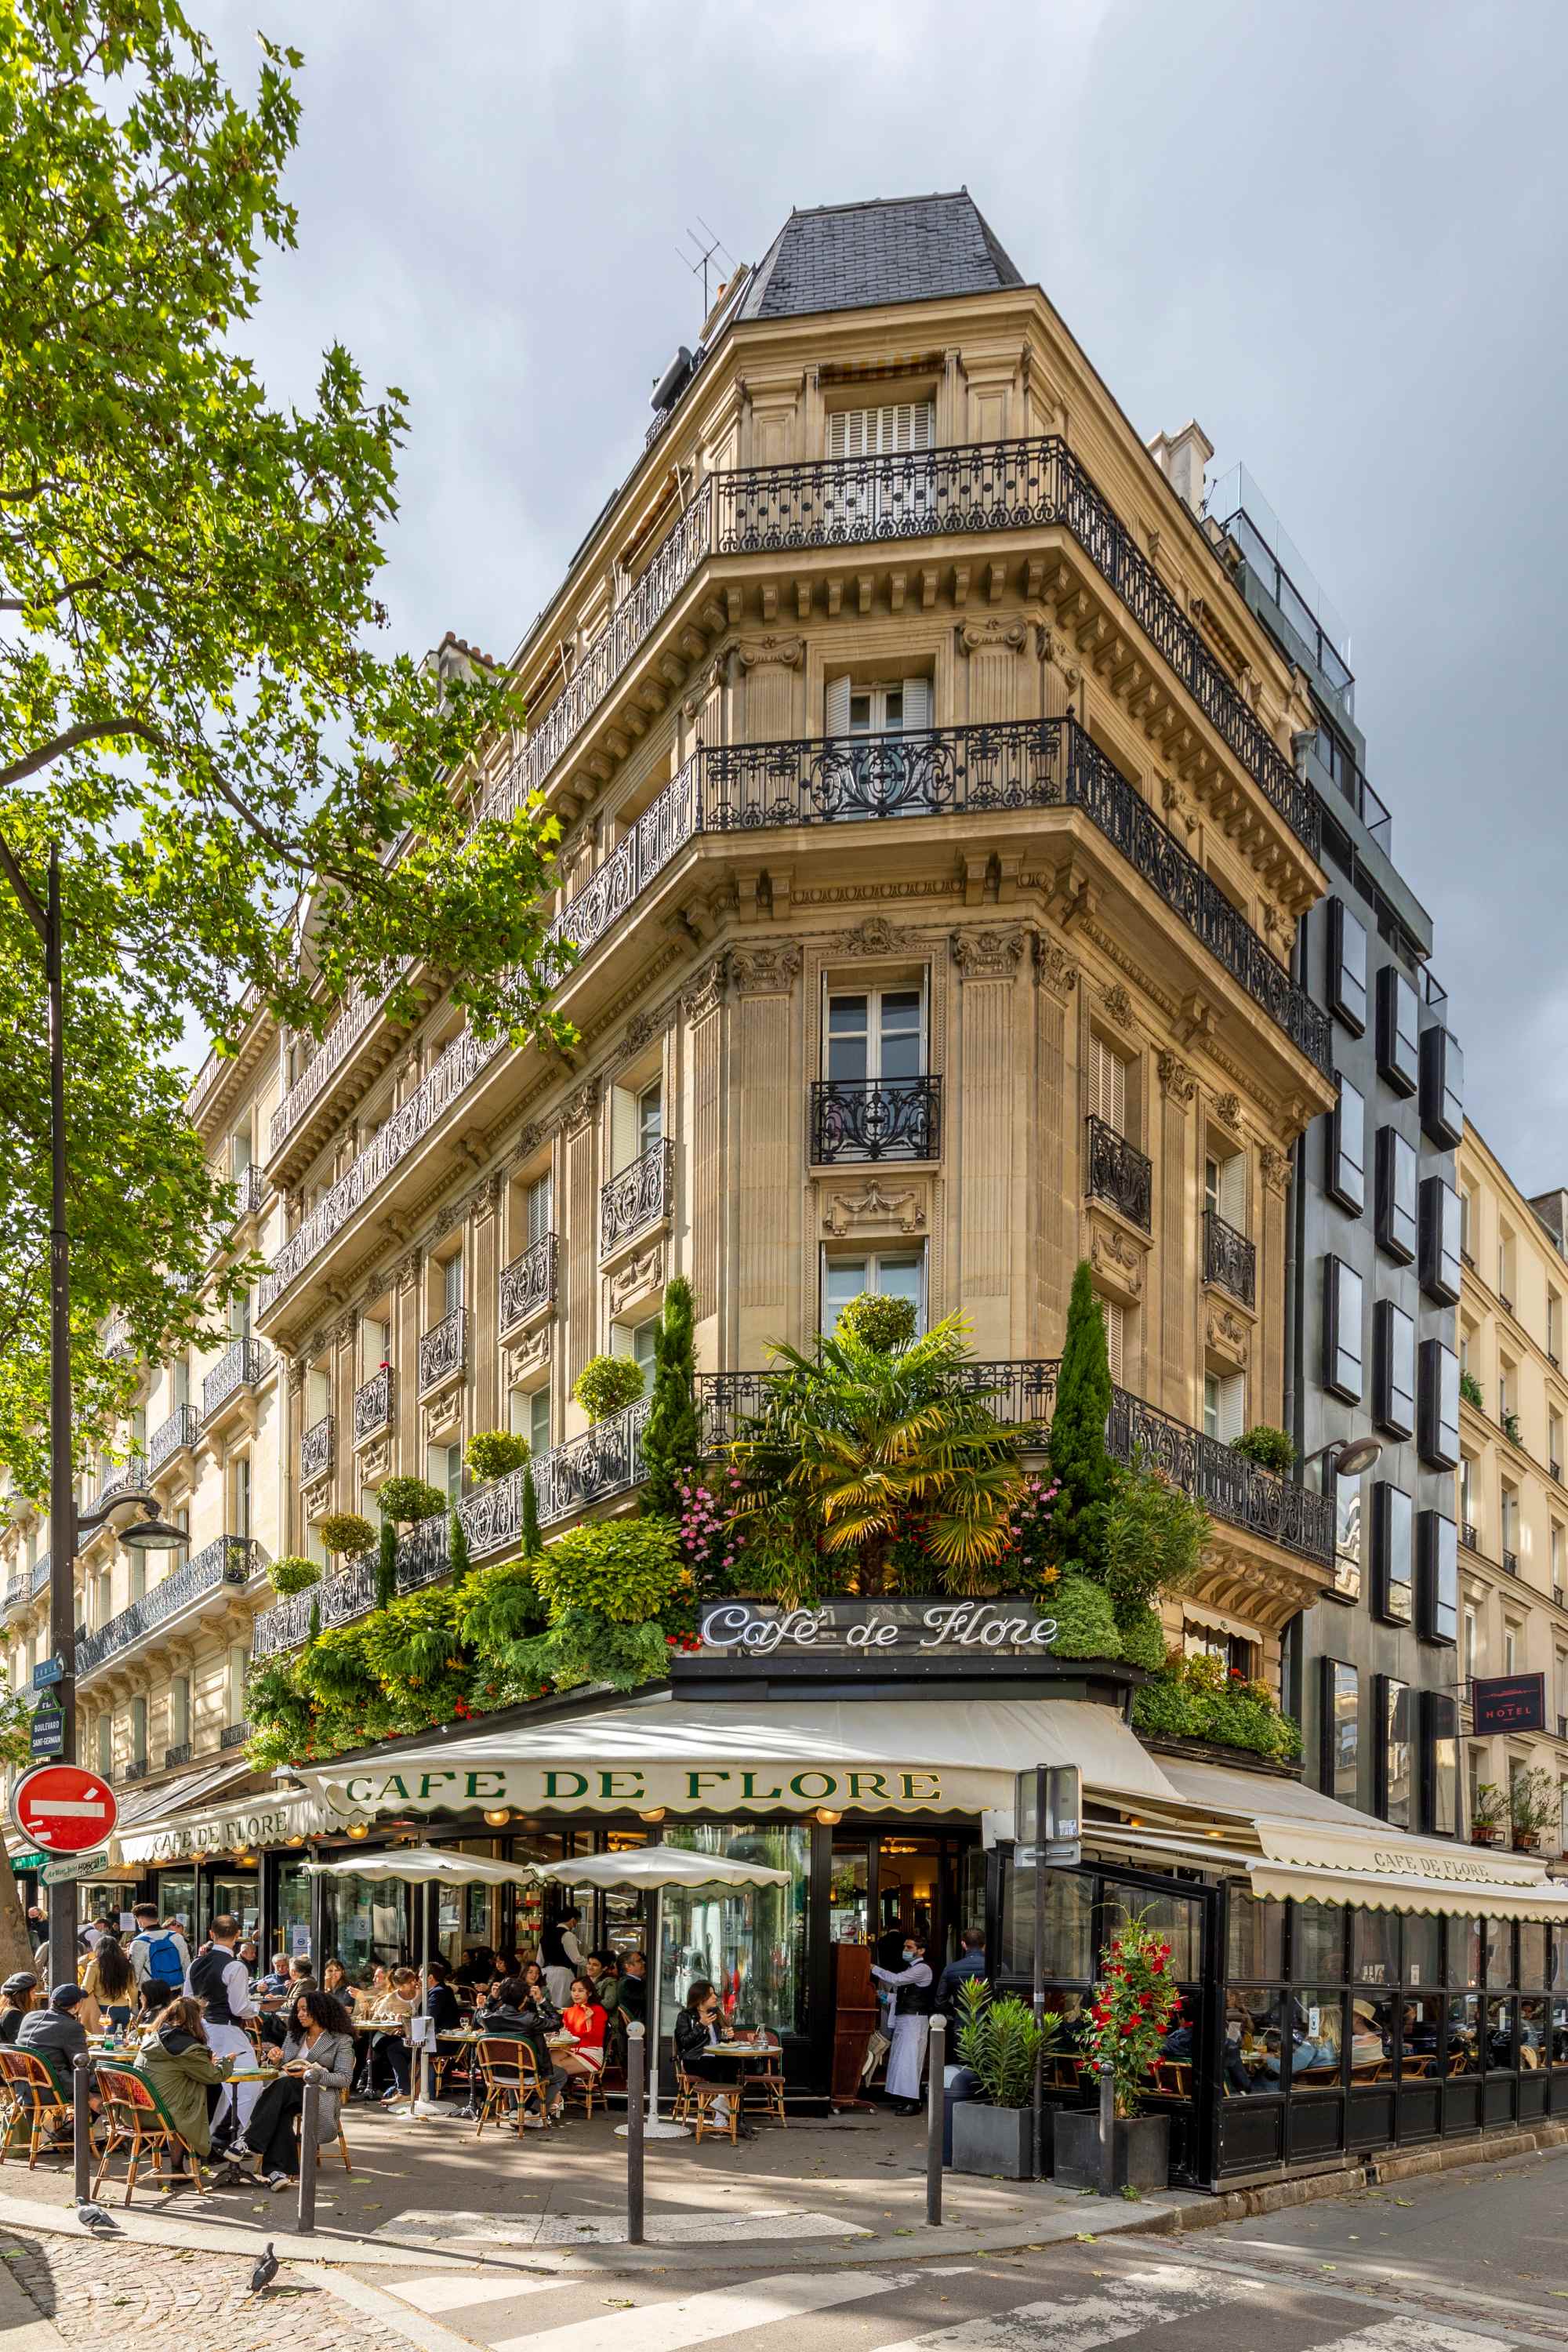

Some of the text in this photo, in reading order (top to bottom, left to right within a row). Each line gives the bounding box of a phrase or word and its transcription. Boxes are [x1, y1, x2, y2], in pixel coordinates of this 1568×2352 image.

[702, 1602, 1058, 1656] Café de Flore
[1486, 1707, 1530, 1719] HOTEL
[34, 1721, 60, 1733] BOULEVARD
[32, 1735, 61, 1748] SAINT-GERMAIN
[346, 1771, 942, 1802] CAFE DE FLORE
[152, 1811, 288, 1853] CAFE DE FLORE
[1374, 1852, 1489, 1877] CAFE DE FLORE
